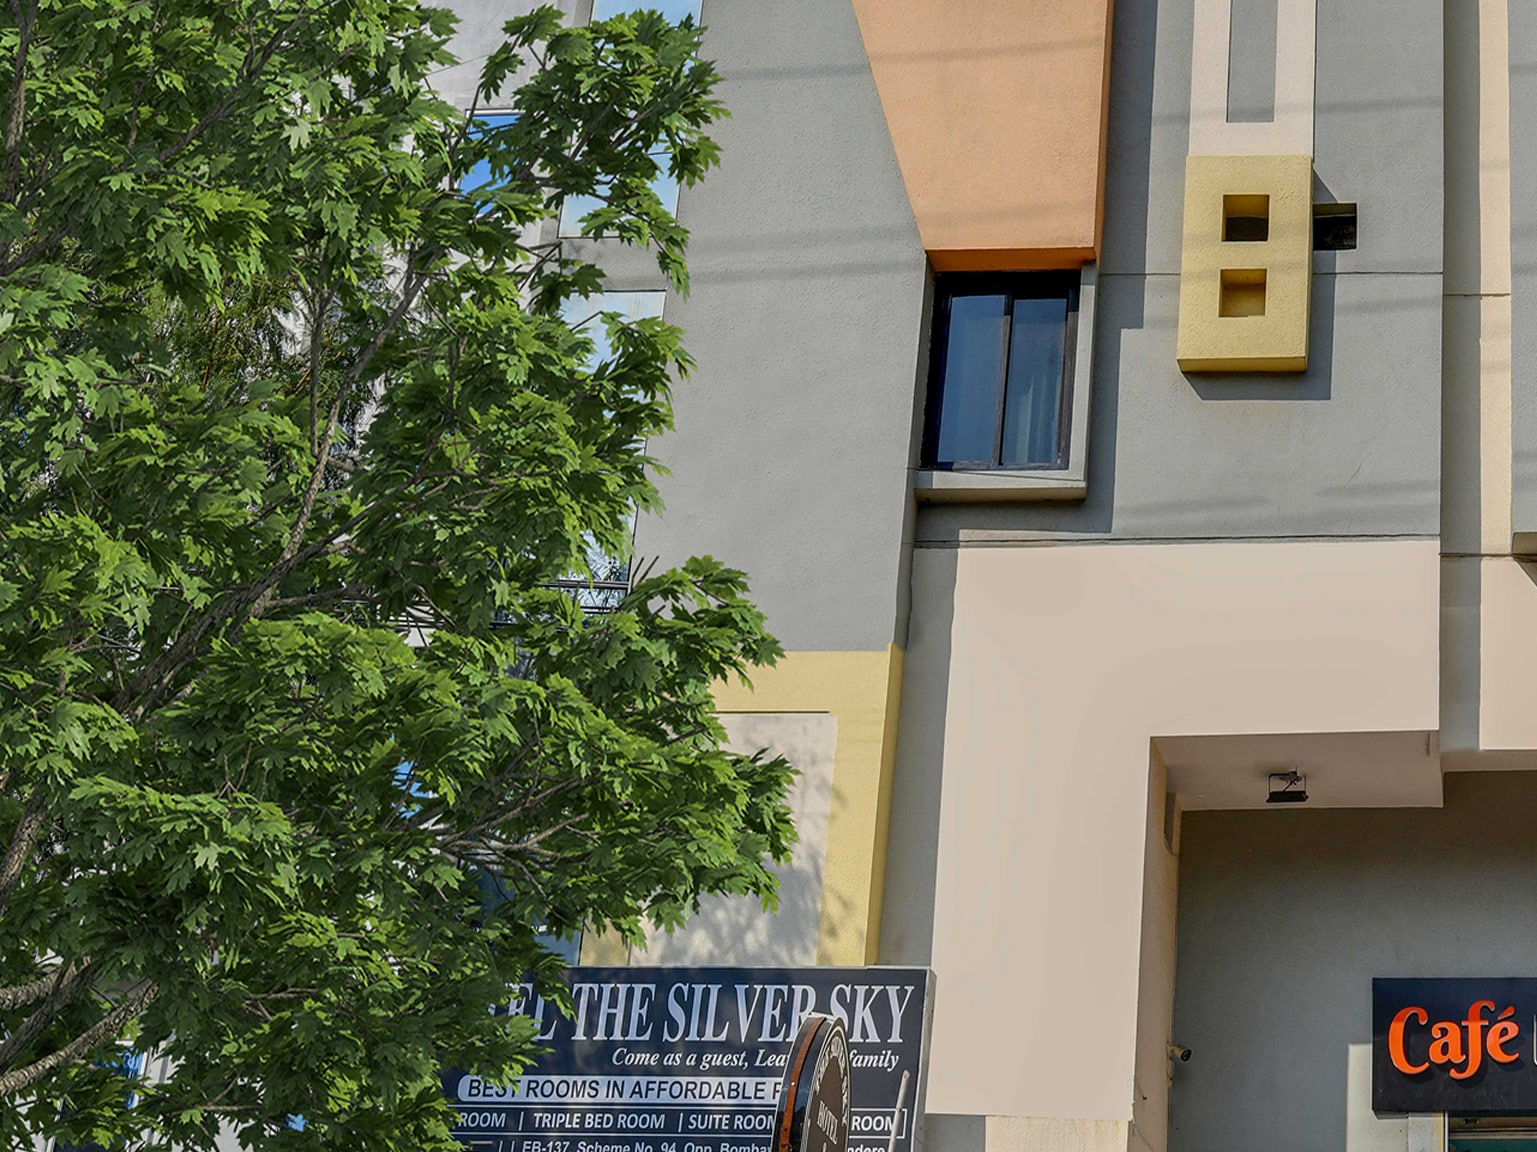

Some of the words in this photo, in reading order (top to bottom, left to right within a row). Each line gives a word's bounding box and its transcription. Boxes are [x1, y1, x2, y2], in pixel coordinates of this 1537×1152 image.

[571, 983, 656, 1042] THE
[662, 981, 817, 1044] SILVER
[830, 983, 915, 1043] SKY
[1387, 999, 1520, 1080] Café
[612, 1047, 658, 1066] Come
[663, 1052, 682, 1067] as
[686, 1052, 697, 1066] a
[700, 1050, 749, 1071] guest,
[849, 1049, 899, 1072] family
[525, 1079, 600, 1099] ROOMS
[605, 1080, 626, 1099] IN
[629, 1080, 767, 1100] AFFORDABLE
[458, 1112, 506, 1128] ROOM
[534, 1112, 581, 1128] TRIPLE
[584, 1113, 614, 1129] BED
[617, 1113, 665, 1129] ROOM
[687, 1114, 729, 1130] SUITE
[522, 1141, 573, 1152] EB-137
[577, 1141, 632, 1152] Scheme
